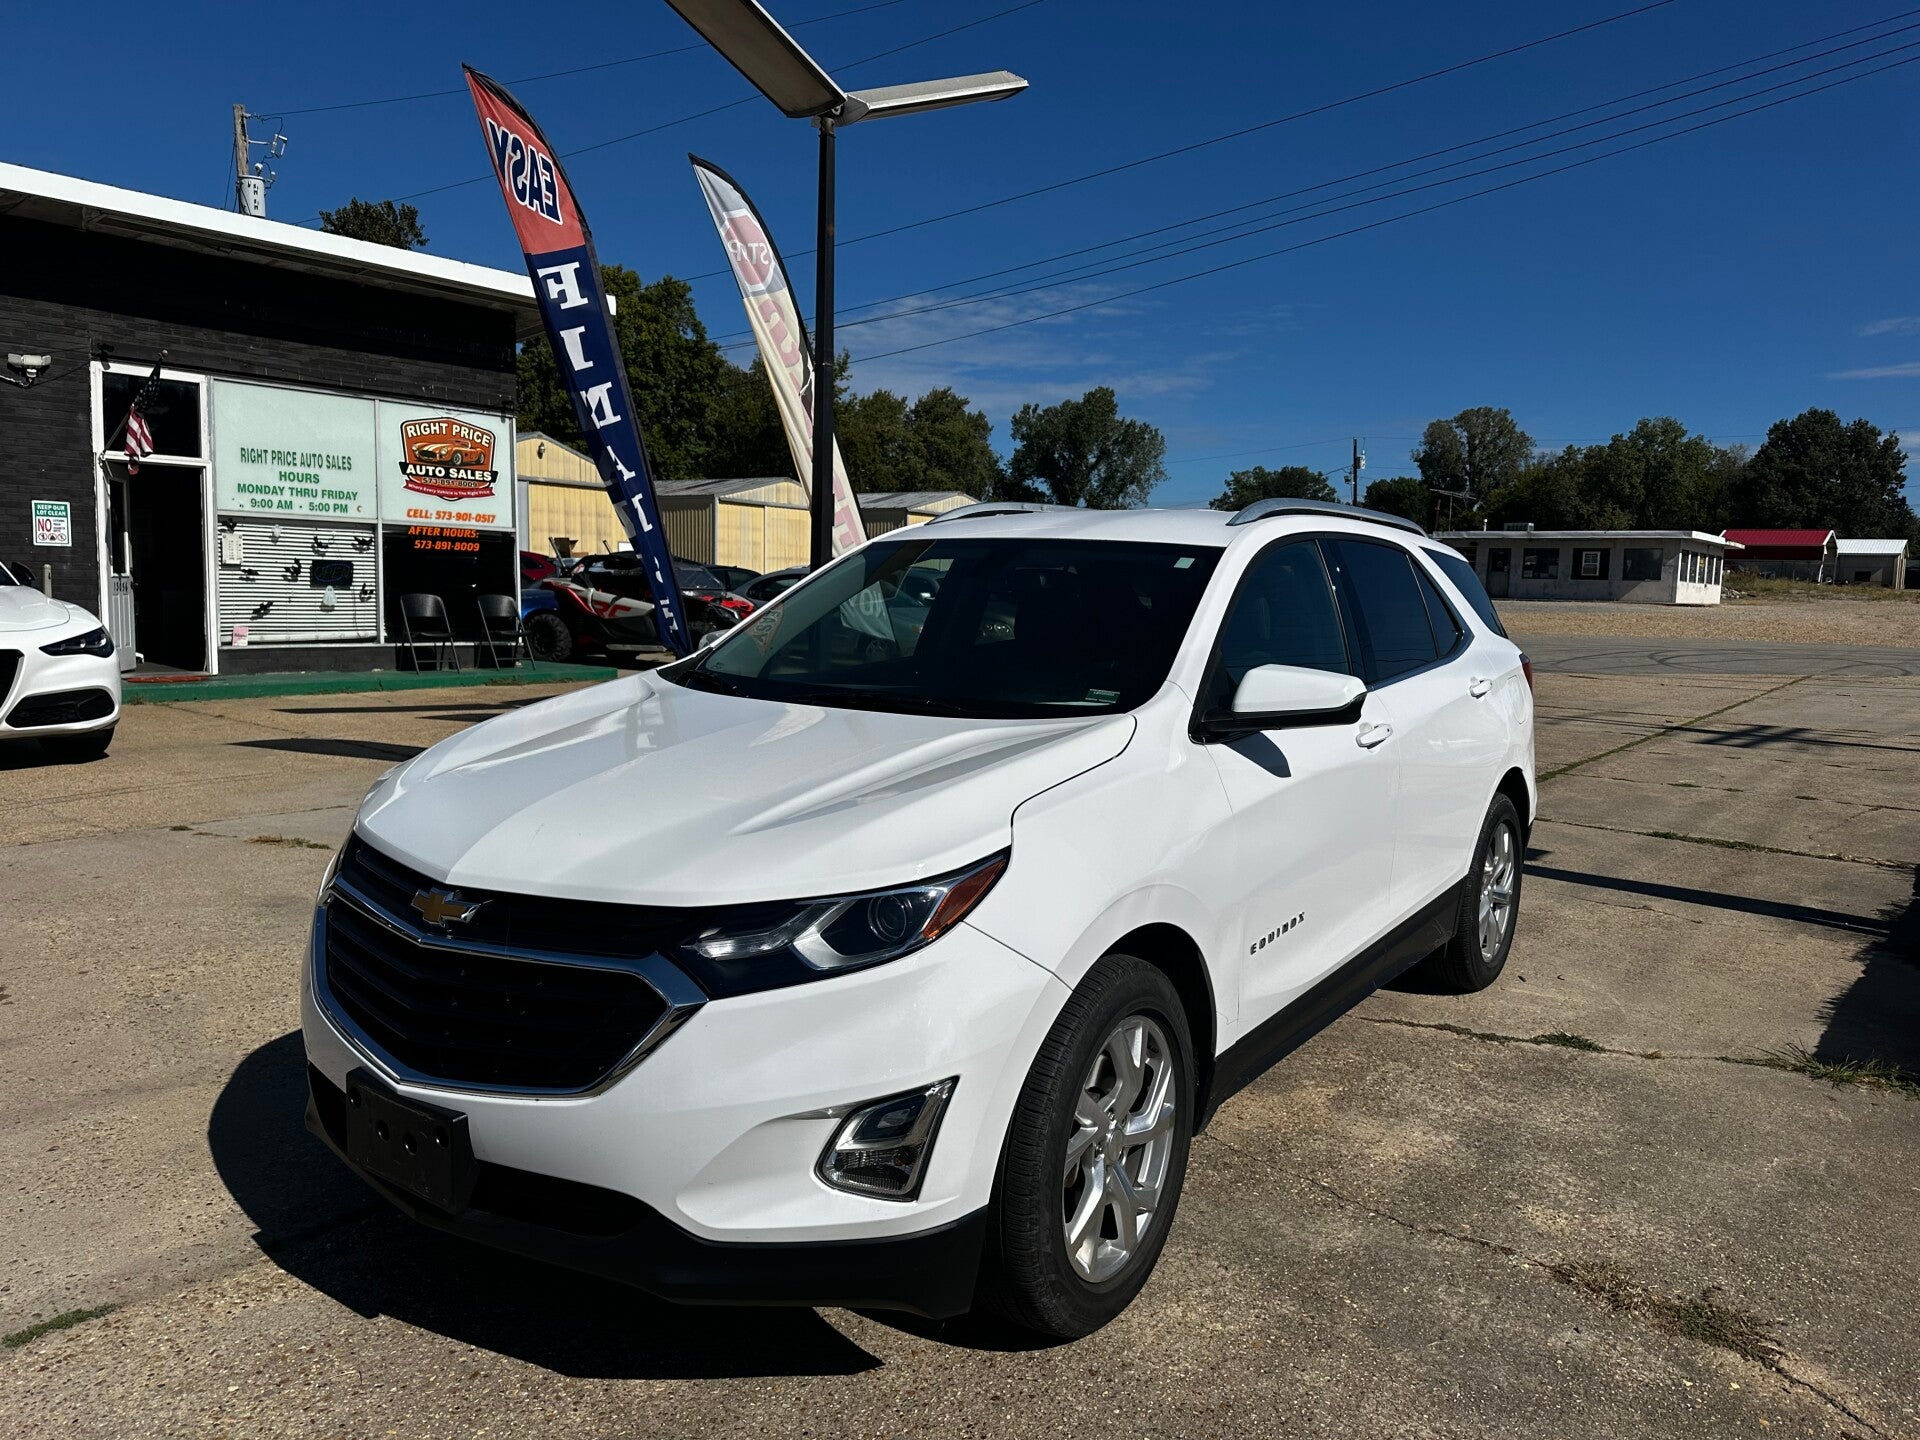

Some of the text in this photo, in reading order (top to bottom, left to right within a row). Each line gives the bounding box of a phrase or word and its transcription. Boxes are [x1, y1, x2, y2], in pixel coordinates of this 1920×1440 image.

[407, 422, 491, 448] RIGHT PRICE
[240, 447, 352, 471] RIGHT PRICE AUTO SALES
[279, 471, 320, 484] HOURS
[406, 464, 492, 481] AUTO SALES
[237, 483, 358, 501] MONDAY THRU FRIDAY
[408, 483, 422, 491] Where
[423, 486, 436, 494] Every
[250, 498, 273, 509] 9:00
[277, 499, 293, 510] AM
[308, 502, 330, 512] 5:00
[333, 503, 348, 513] PM
[407, 508, 496, 523] CELL: 573-901-0517
[37, 518, 52, 532] NO
[408, 526, 479, 538] AFTER HOURS:
[414, 540, 480, 552] 573-891-8009
[1250, 911, 1305, 956] EQUINOX
